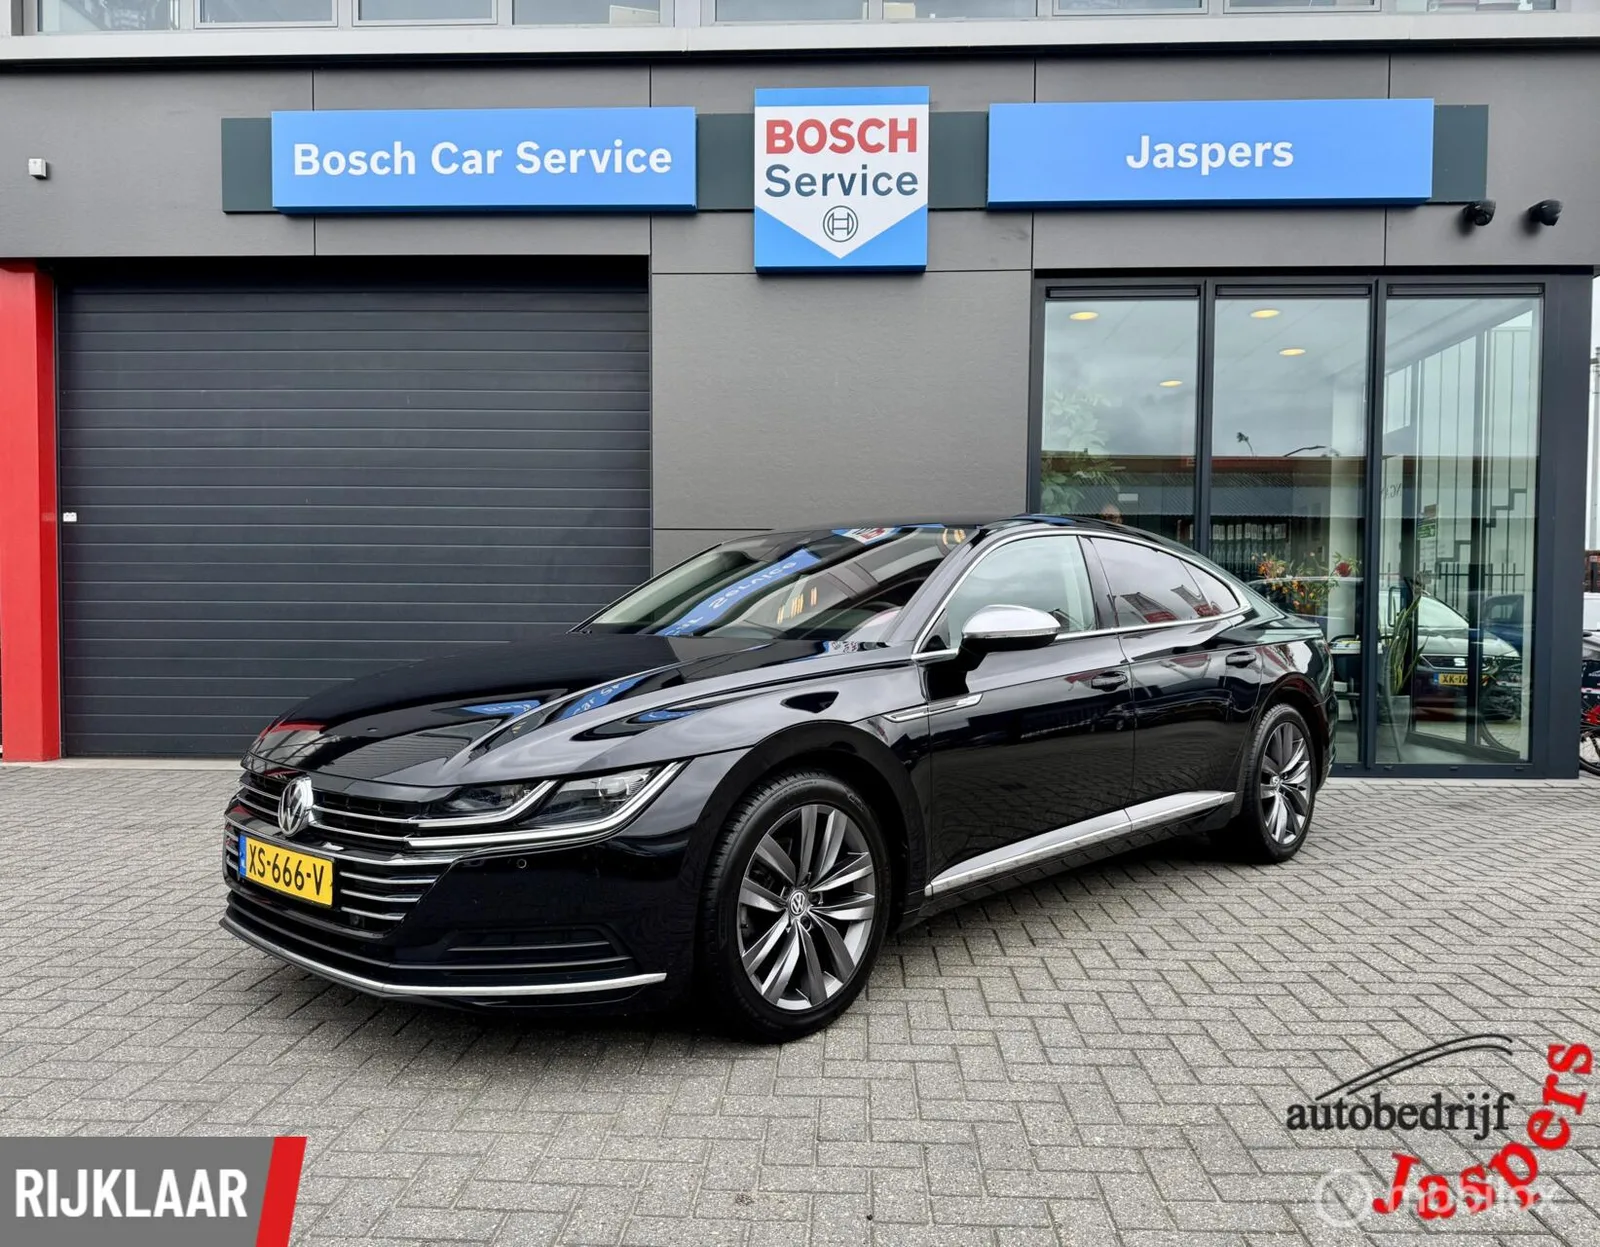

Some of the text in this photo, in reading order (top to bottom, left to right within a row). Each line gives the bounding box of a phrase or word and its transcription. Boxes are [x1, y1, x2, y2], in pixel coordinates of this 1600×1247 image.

[766, 117, 917, 154] BOSCH
[293, 138, 672, 176] Bosch Car Service
[1126, 135, 1294, 176] Jaspers
[764, 163, 919, 197] Service
[249, 843, 324, 896] XS-666-V
